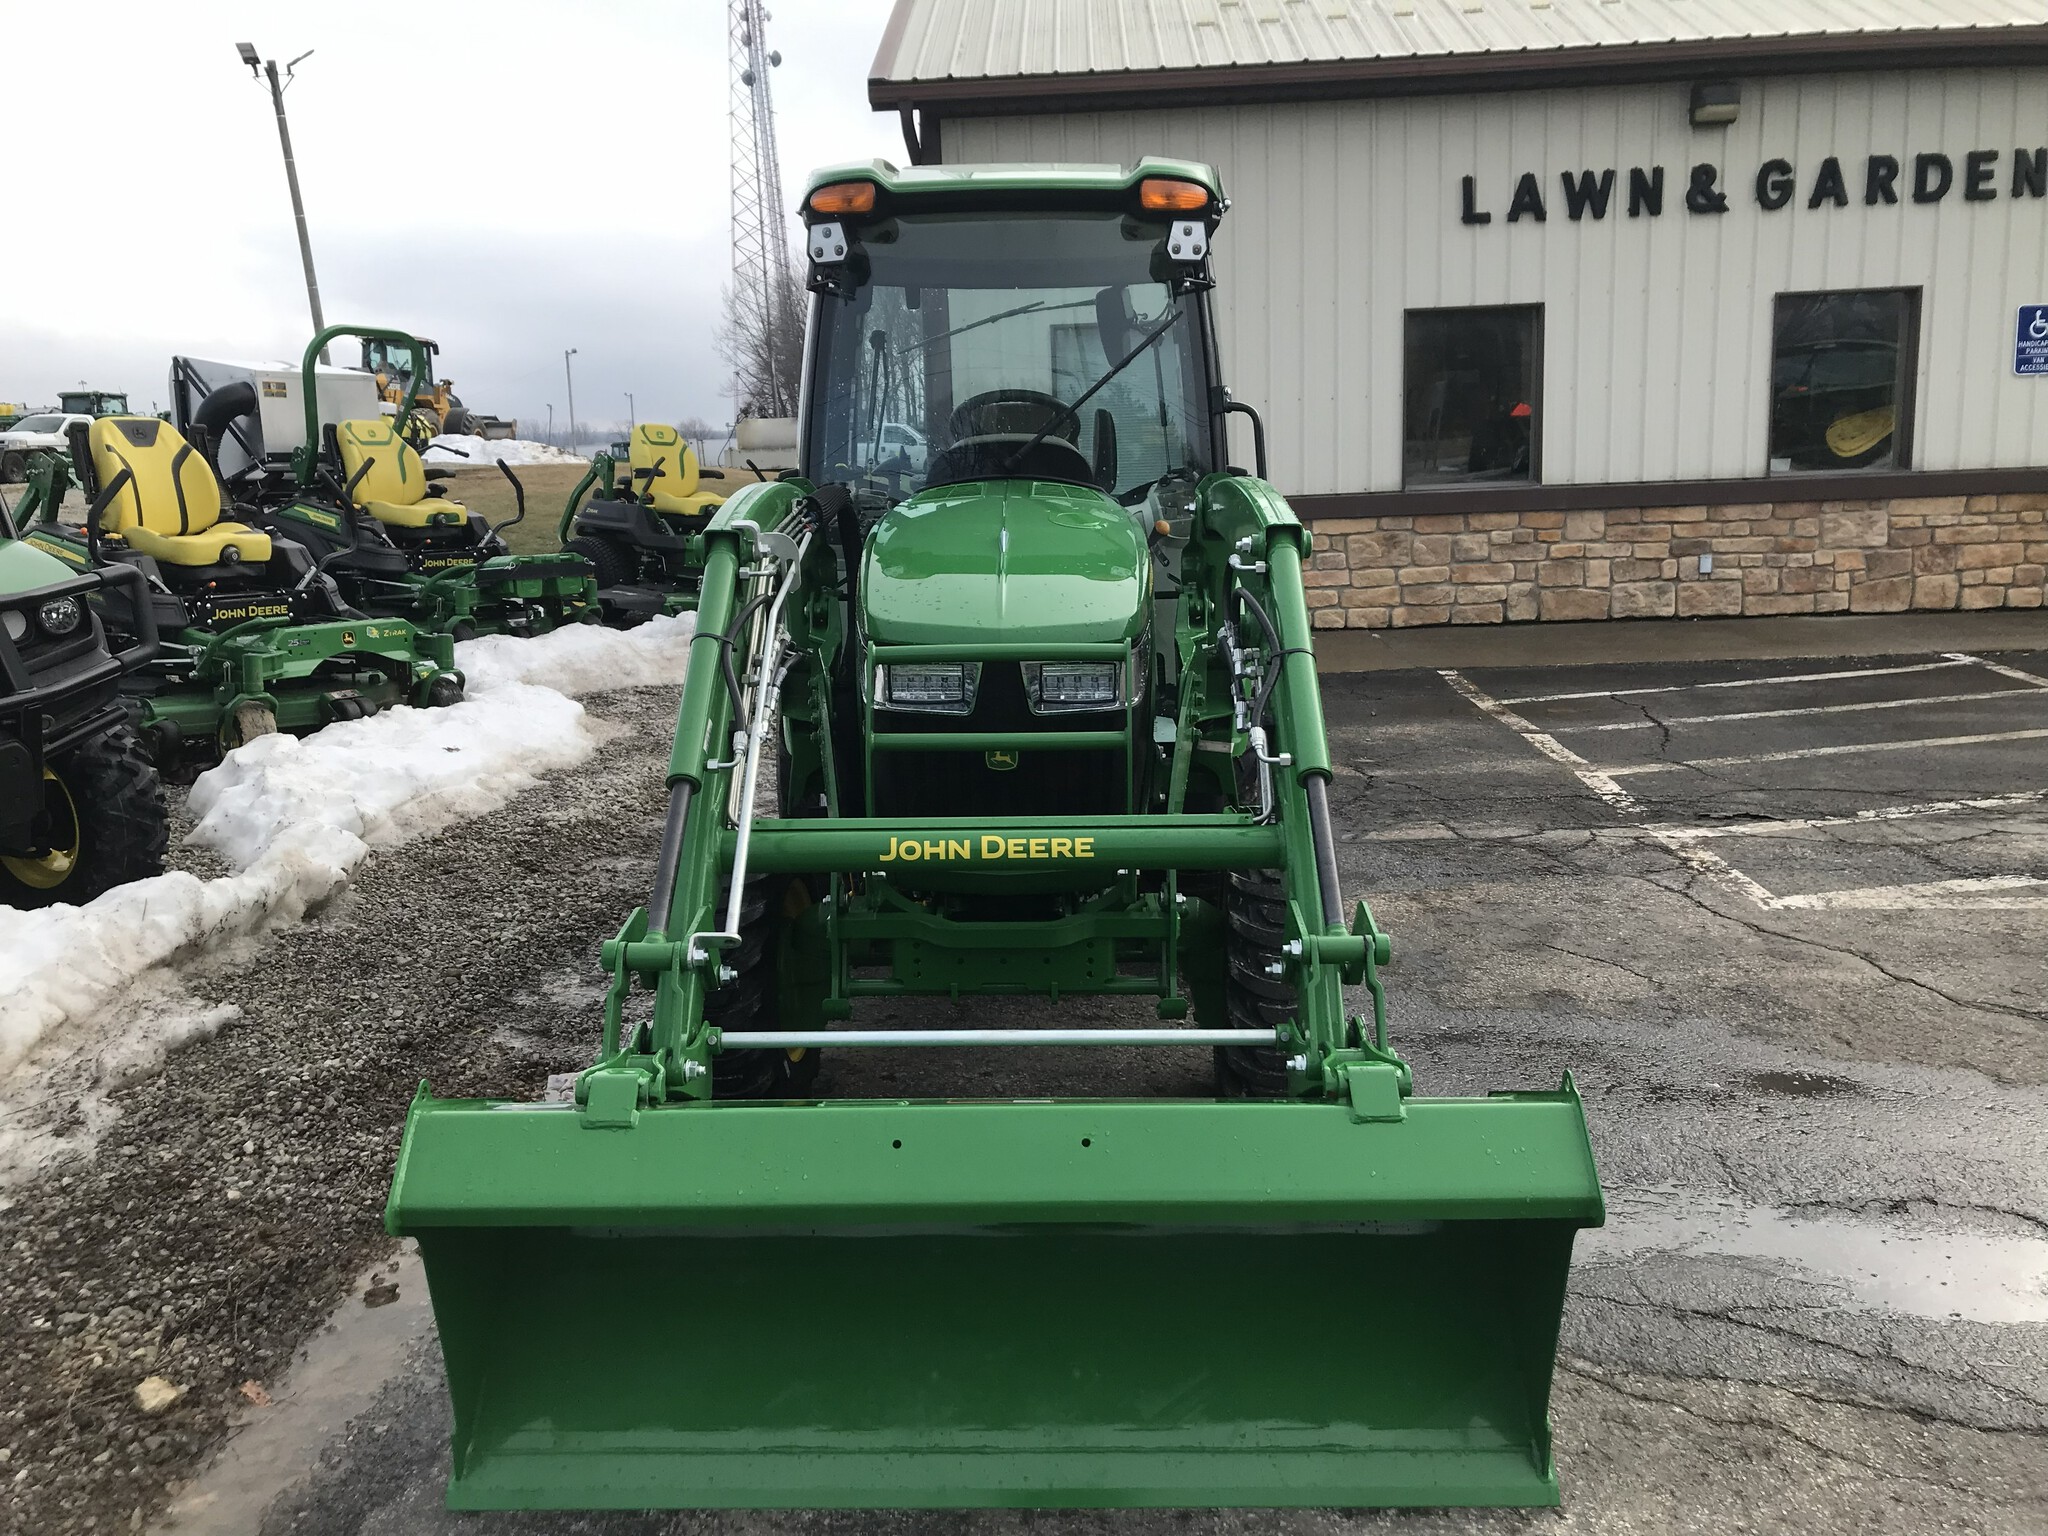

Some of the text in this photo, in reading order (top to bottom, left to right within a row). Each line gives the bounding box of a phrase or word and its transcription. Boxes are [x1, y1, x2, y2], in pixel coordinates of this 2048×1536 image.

[1460, 146, 2048, 225] LAWN & GARDEN
[422, 557, 475, 568] JOHN DEERE
[211, 604, 289, 620] JOHN DEERE
[879, 835, 1095, 862] JOHN DEERE
